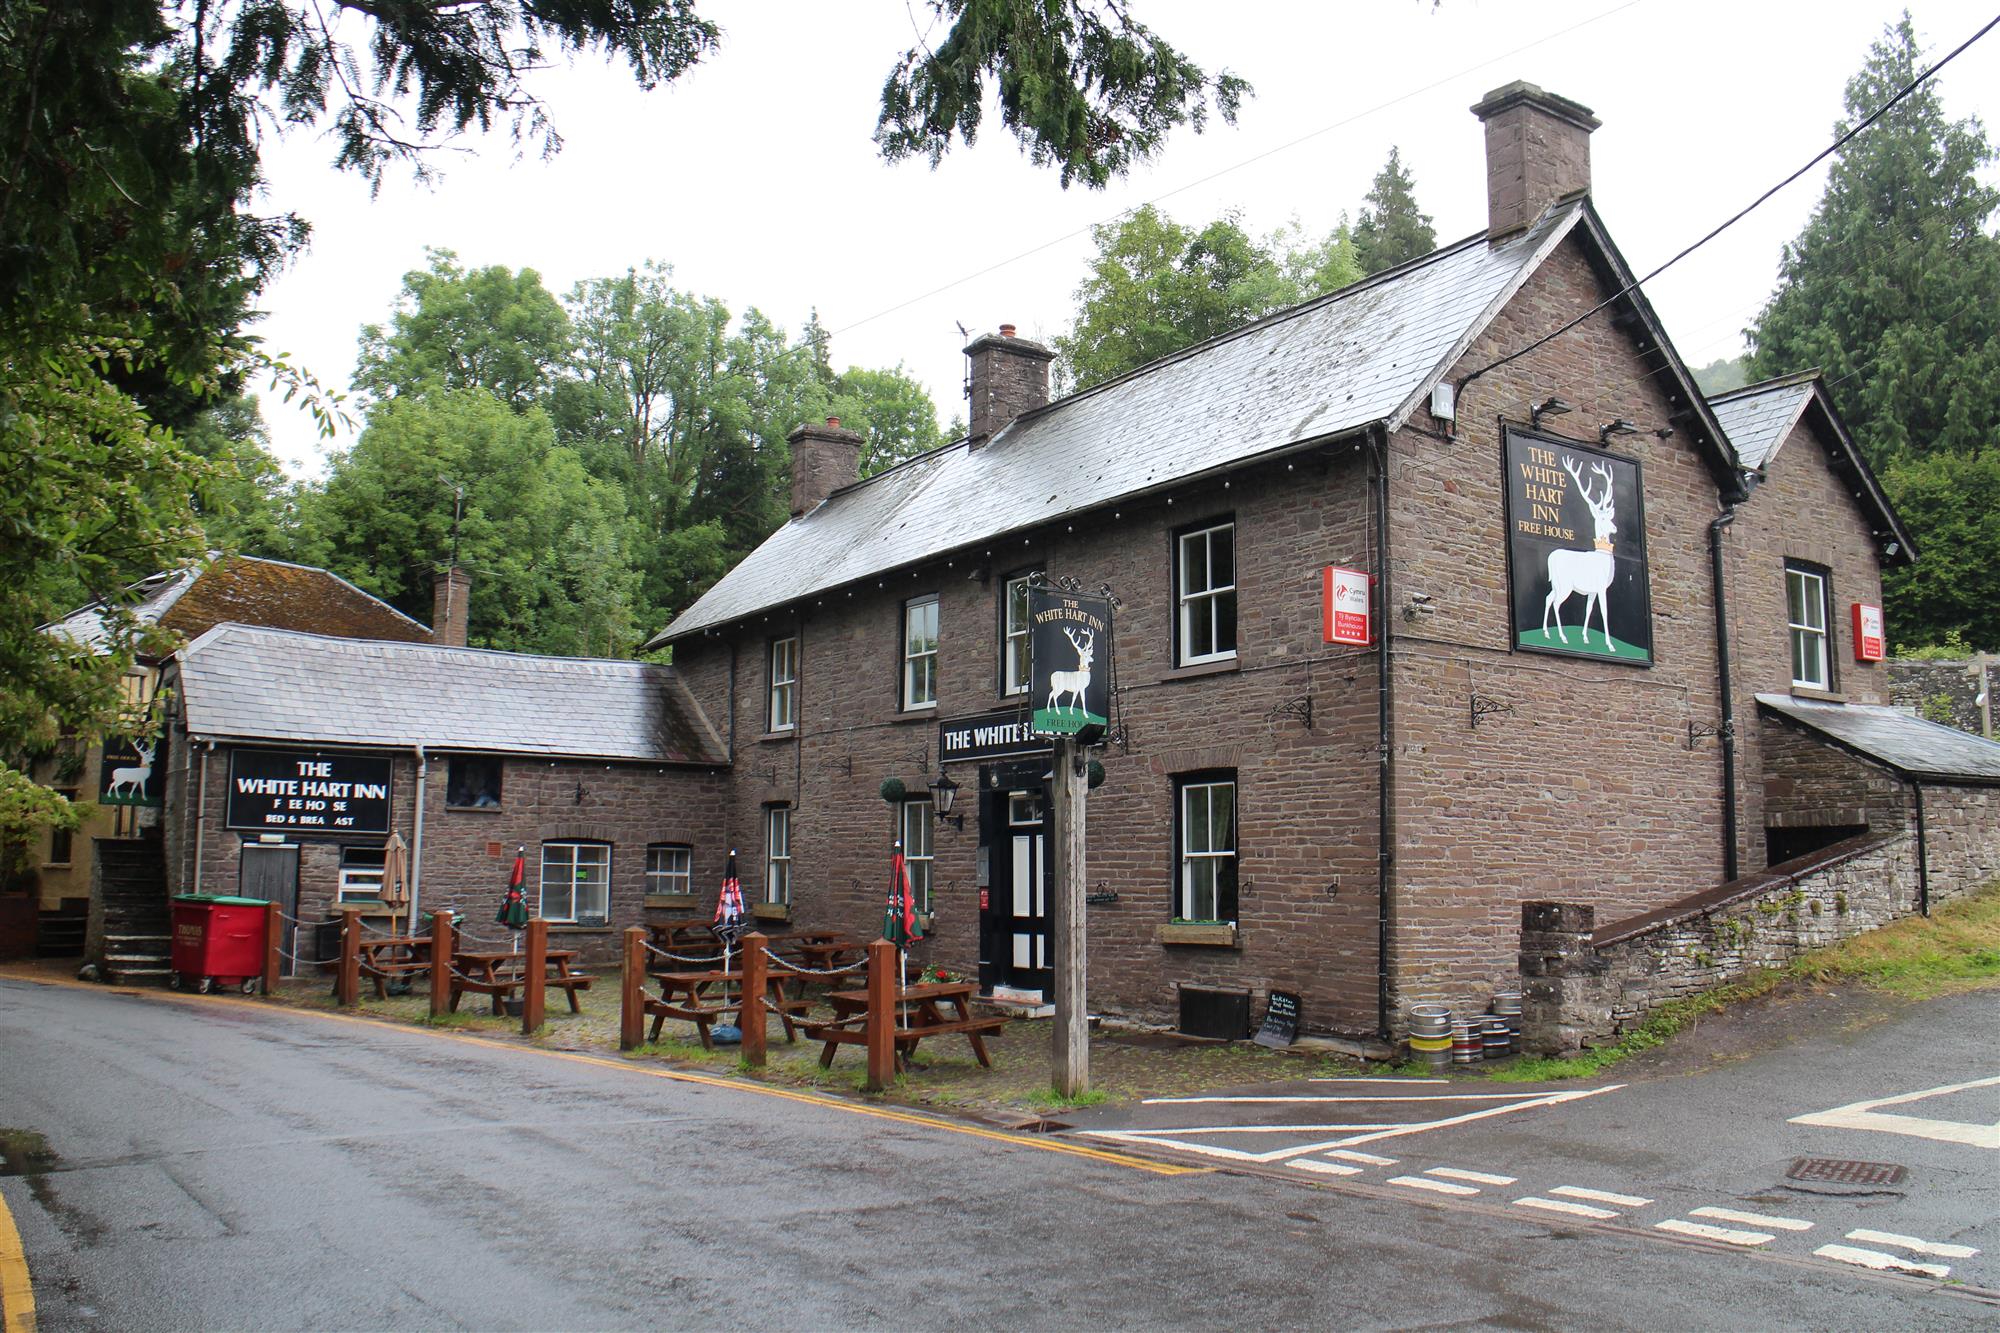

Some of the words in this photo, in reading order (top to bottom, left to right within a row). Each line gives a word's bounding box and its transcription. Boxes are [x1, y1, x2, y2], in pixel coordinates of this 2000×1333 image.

[1527, 446, 1557, 468] THE
[1520, 463, 1567, 488] WHITE
[1525, 483, 1564, 506] HART
[1532, 503, 1560, 525] INN
[1518, 520, 1542, 535] FREE
[1544, 524, 1575, 541] HOUSE
[1349, 587, 1366, 597] Cymru
[1063, 599, 1079, 609] THE
[1035, 608, 1064, 625] WHITE
[1065, 608, 1088, 623] HART
[1088, 615, 1105, 632] INN
[1046, 719, 1066, 728] FREE
[945, 729, 971, 750] THE
[974, 723, 1020, 748] WHITE
[296, 761, 332, 778] THE
[236, 778, 298, 796] WHITE
[301, 781, 352, 798] HART
[354, 783, 387, 800] INN
[273, 799, 303, 810] FEE
[305, 801, 348, 812] HOSE
[265, 814, 286, 824] BED
[287, 815, 297, 824] &
